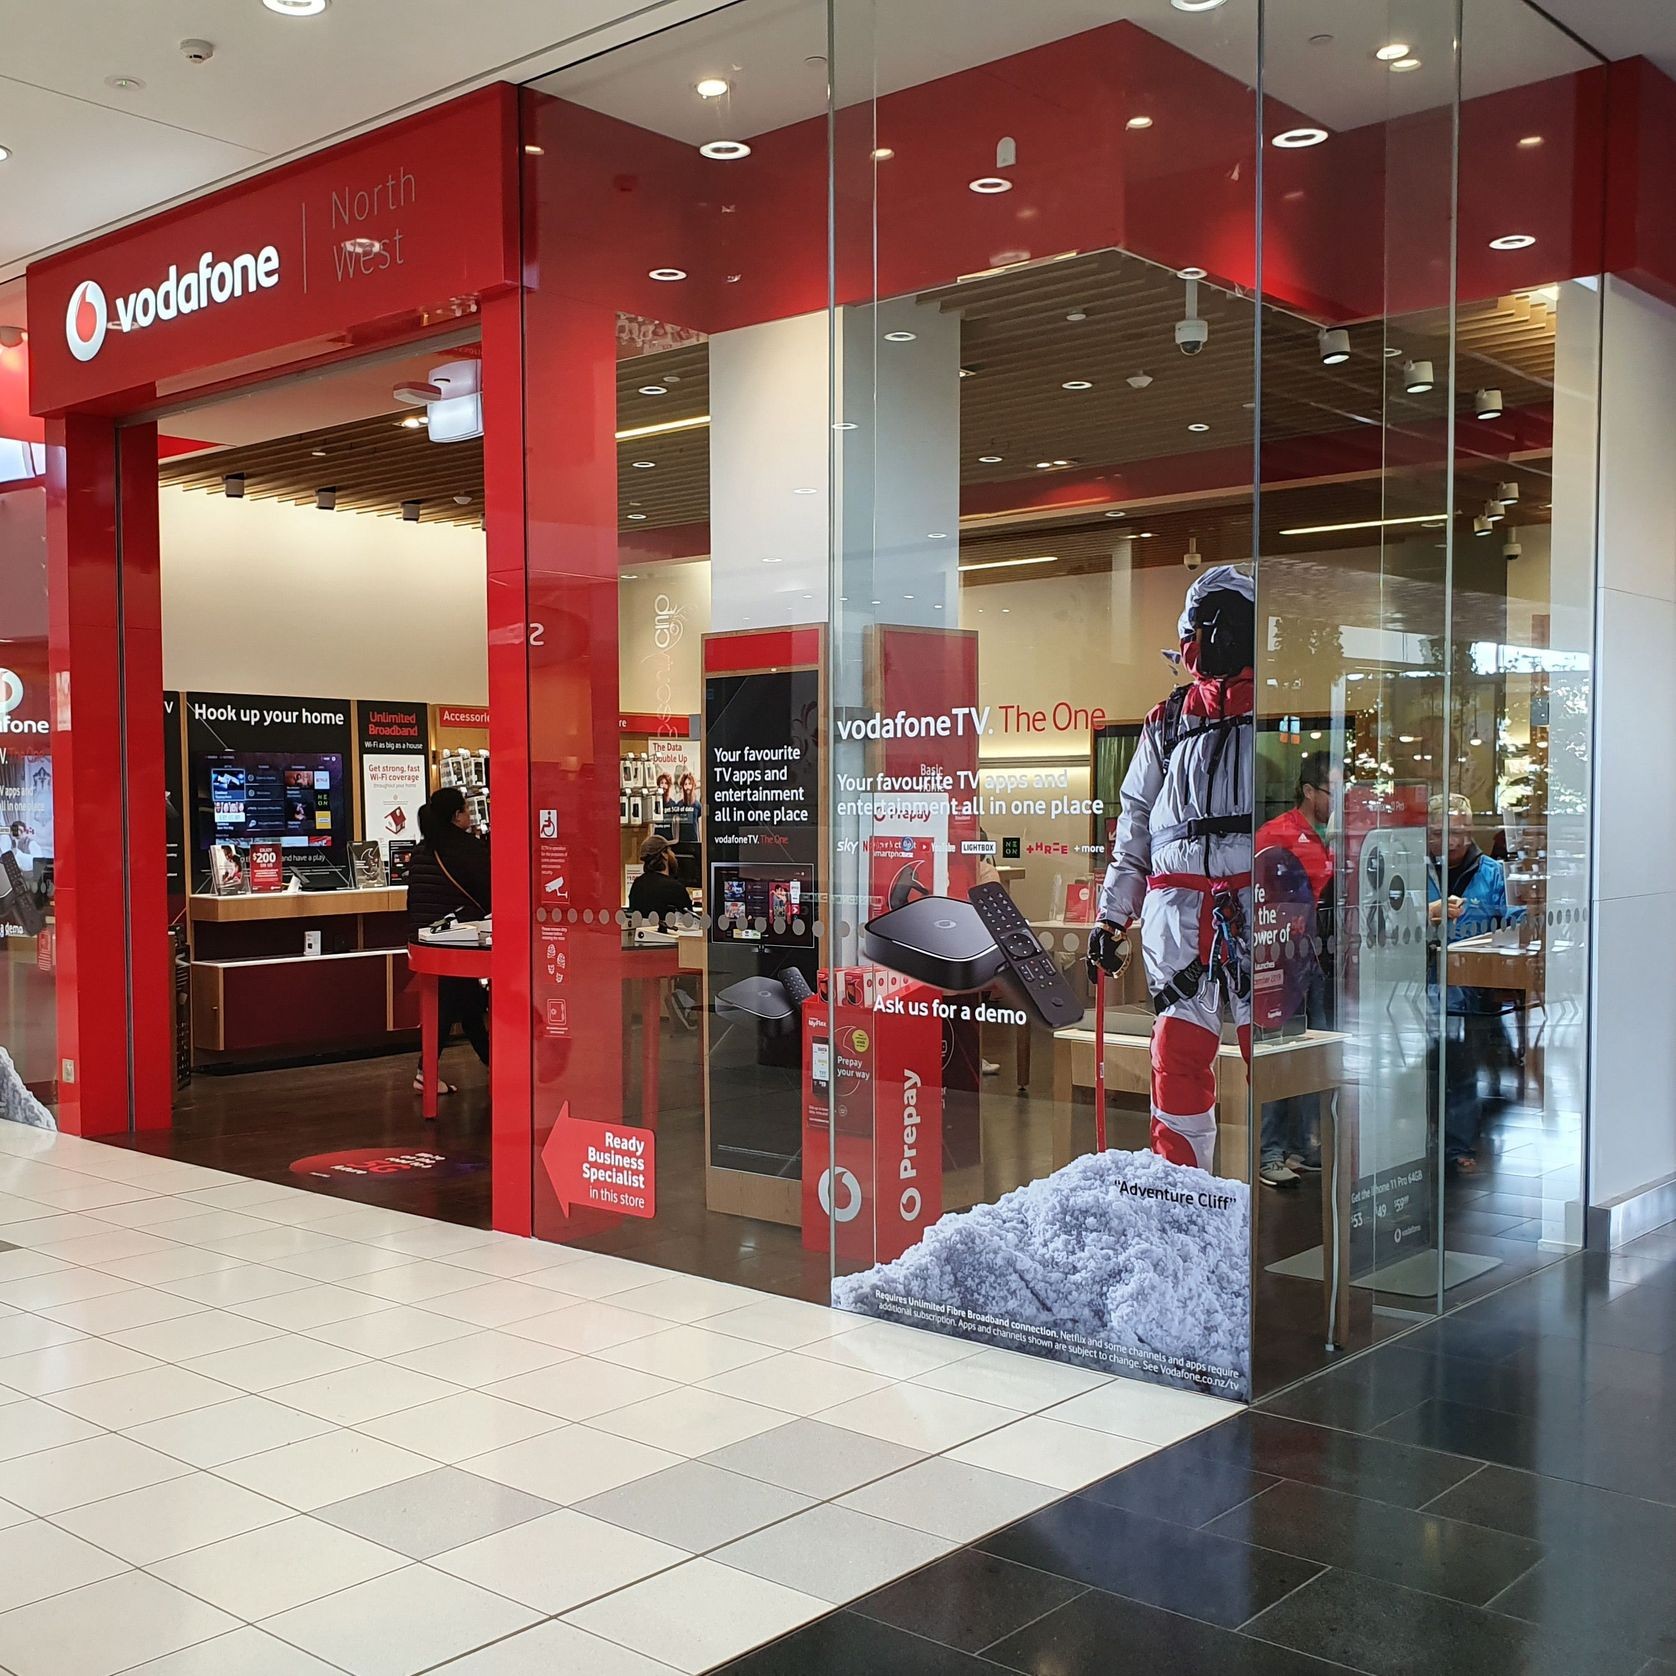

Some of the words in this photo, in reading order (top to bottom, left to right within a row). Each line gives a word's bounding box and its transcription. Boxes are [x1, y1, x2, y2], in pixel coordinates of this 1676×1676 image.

[331, 167, 416, 228] North
[334, 228, 404, 282] West
[115, 246, 280, 332] vodafone
[194, 703, 236, 720] Hook
[240, 710, 260, 725] up
[264, 710, 299, 726] your
[302, 708, 344, 725] home
[370, 712, 416, 724] Unlimited
[998, 705, 1046, 734] The
[1052, 702, 1106, 732] One
[368, 724, 418, 736] Broadband
[386, 742, 394, 750] big
[653, 743, 666, 752] The
[666, 742, 682, 752] Data
[714, 747, 741, 762] Your
[744, 745, 800, 761] favourite
[368, 764, 380, 772] Get
[407, 764, 420, 772] fast
[653, 753, 678, 764] Double
[678, 754, 688, 765] Up
[370, 773, 388, 781] Wi-Fi
[388, 774, 420, 782] coverage
[714, 767, 732, 782] TV
[733, 769, 762, 785] apps
[764, 766, 788, 780] and
[920, 764, 944, 776] Basic
[837, 772, 873, 792] Your
[876, 773, 953, 791] favourite
[956, 770, 980, 790] TV
[984, 773, 1028, 794] apps
[1033, 770, 1068, 790] and
[714, 786, 804, 802] entertainment
[714, 807, 730, 822] all
[733, 808, 744, 821] in
[748, 810, 770, 822] one
[774, 806, 808, 825] place
[837, 797, 959, 816] entertainment
[962, 796, 984, 815] all
[990, 794, 1006, 815] in
[1011, 799, 1046, 816] one
[1050, 795, 1104, 820] place
[714, 834, 760, 844] vodafoneTV.
[760, 834, 774, 844] The
[775, 834, 789, 845] One
[836, 838, 858, 854] sky
[964, 843, 994, 852] LIGHTBOX
[252, 852, 276, 863] $200
[313, 854, 326, 863] play
[1258, 906, 1276, 925] the
[1280, 922, 1291, 943] of
[873, 995, 904, 1014] Ask
[909, 1000, 928, 1016] us
[932, 999, 958, 1019] for
[960, 1005, 971, 1020] a
[975, 1003, 1027, 1026] demo
[837, 1056, 862, 1069] Prepay
[837, 1068, 854, 1078] your
[856, 1070, 870, 1081] way
[900, 1068, 922, 1180] Prepay
[605, 1132, 645, 1156] Ready
[588, 1146, 644, 1170] Business
[582, 1163, 645, 1189] Specialist
[590, 1186, 598, 1199] in
[600, 1187, 618, 1203] this
[620, 1193, 645, 1208] store
[1352, 1192, 1361, 1203] Get
[1397, 1177, 1407, 1186] Pro
[876, 1290, 907, 1304] Requires
[908, 1296, 945, 1313] Unlimited
[946, 1306, 966, 1318] Fibre
[968, 1310, 1009, 1327] Broadband
[1011, 1321, 1058, 1338] connection.
[1060, 1331, 1086, 1344] Netflix
[1088, 1337, 1102, 1348] and
[1104, 1342, 1127, 1354] some
[1128, 1344, 1166, 1362] channels
[1168, 1355, 1184, 1367] and
[1186, 1360, 1206, 1373] apps
[1208, 1364, 1239, 1378] require
[878, 1302, 912, 1316] additional
[913, 1308, 957, 1327] subscription.
[958, 1321, 976, 1332] Apps
[978, 1324, 991, 1334] and
[993, 1325, 1026, 1342] channels
[1028, 1332, 1053, 1349] shown
[1055, 1341, 1067, 1351] are
[1068, 1344, 1097, 1360] subject
[1099, 1350, 1108, 1360] to
[1109, 1353, 1141, 1369] change.
[1143, 1360, 1159, 1373] See
[1160, 1364, 1240, 1391] Vodafone.co.nz/tv
